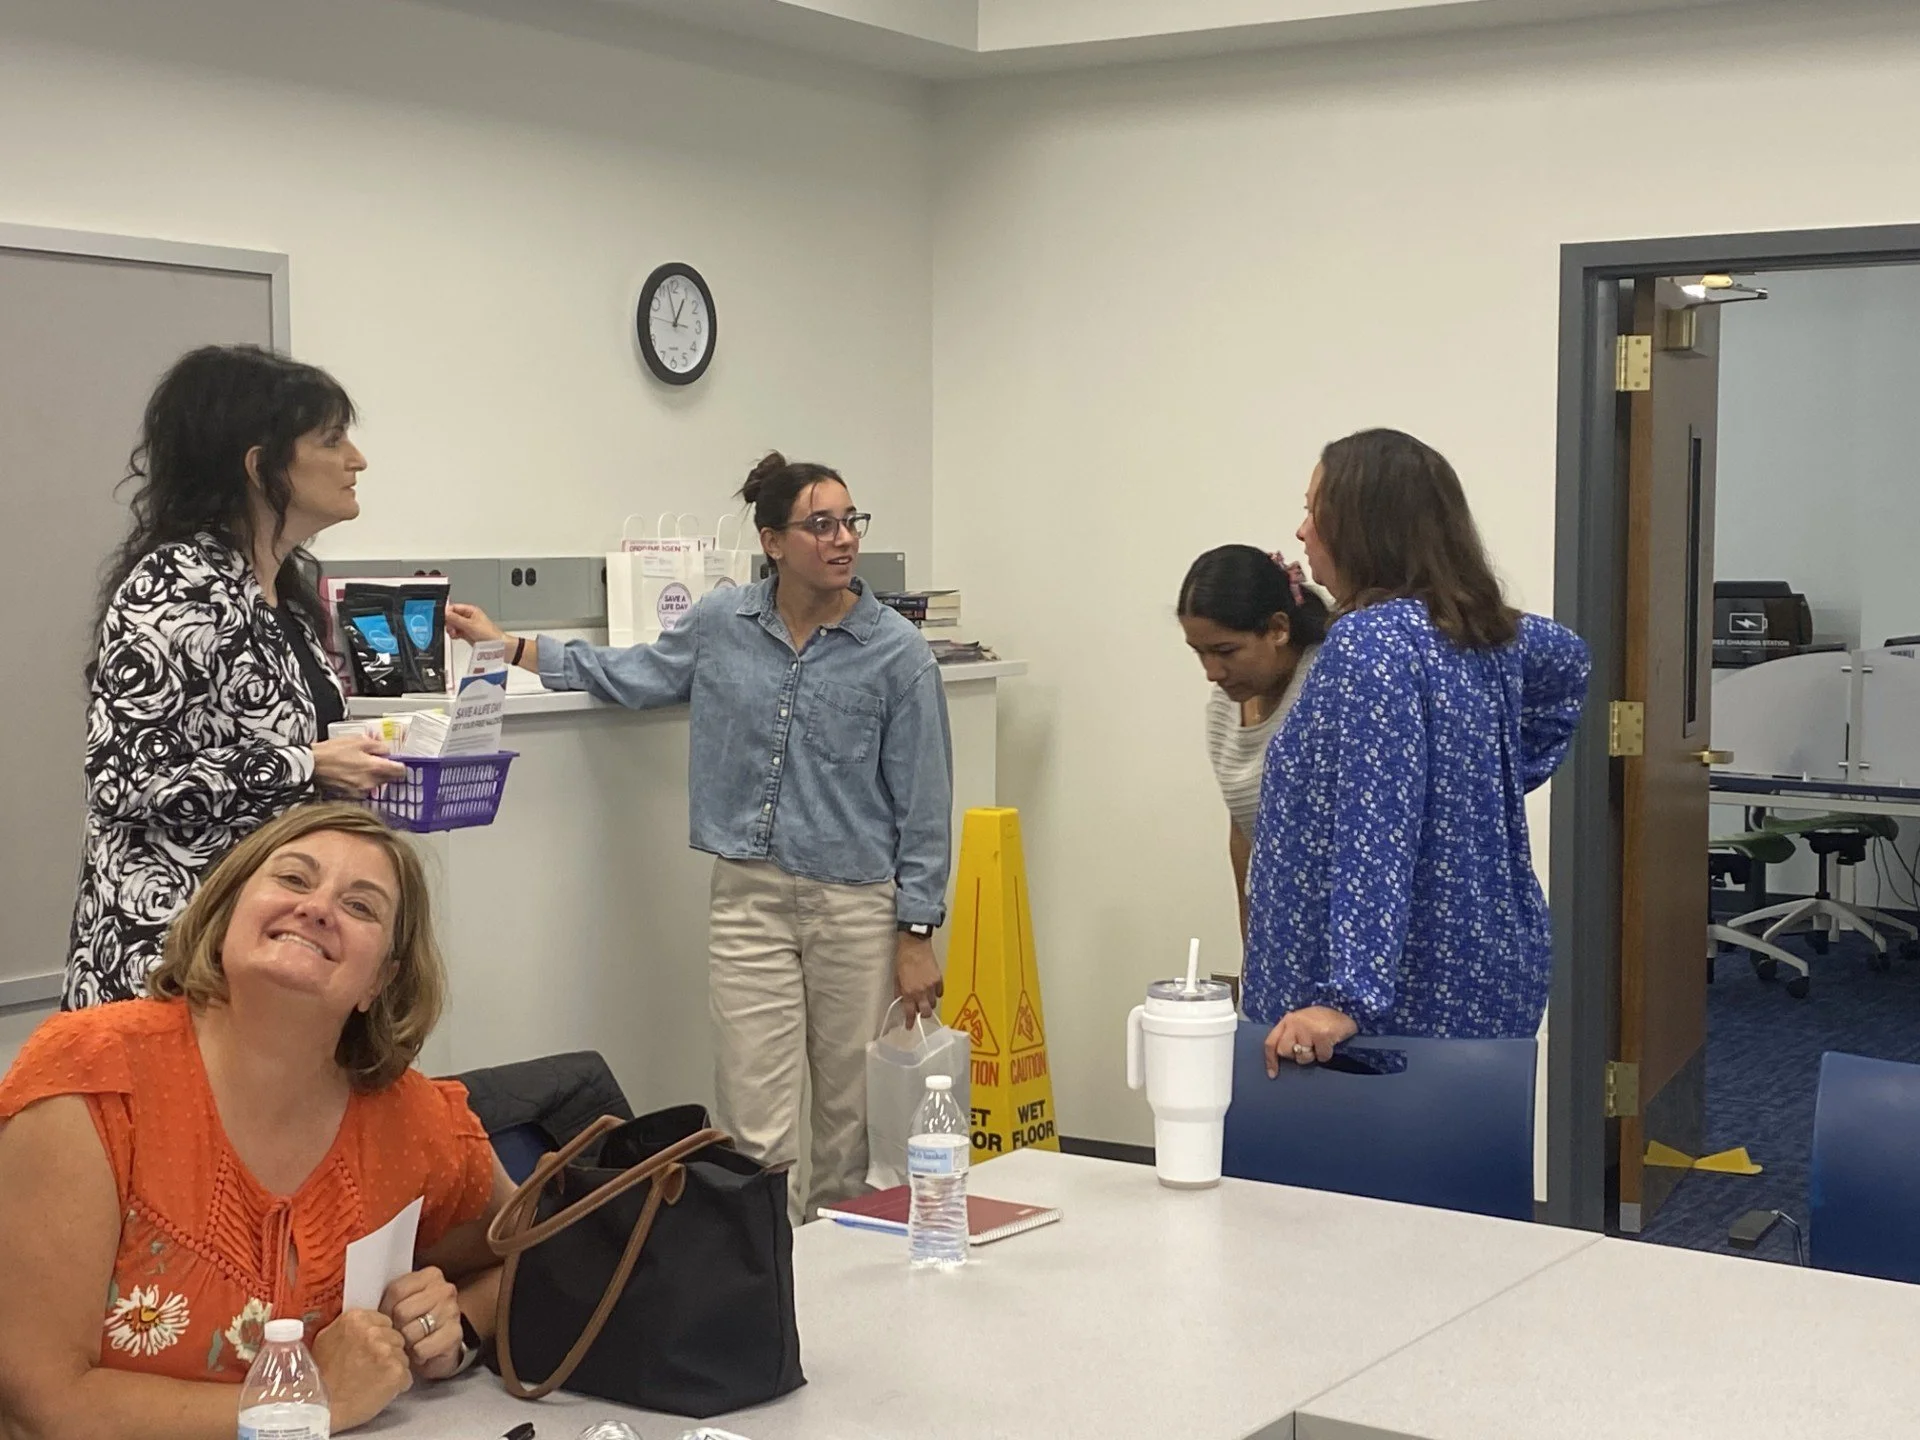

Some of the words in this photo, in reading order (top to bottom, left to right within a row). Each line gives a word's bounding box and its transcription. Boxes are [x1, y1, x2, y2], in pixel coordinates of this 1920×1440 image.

[670, 279, 679, 294] 12
[691, 300, 699, 315] 2
[694, 320, 702, 335] 3
[689, 341, 697, 352] 4
[659, 350, 667, 363] 7
[669, 356, 678, 370] 6
[681, 352, 688, 367] 5
[675, 603, 688, 611] DAY
[455, 706, 473, 719] SAVE
[478, 703, 492, 715] LIFE
[970, 1060, 999, 1087] TION
[1011, 1051, 1047, 1085] CAUTION
[970, 1108, 991, 1127] ET
[1017, 1099, 1046, 1124] WET
[1012, 1120, 1055, 1152] FLOOR
